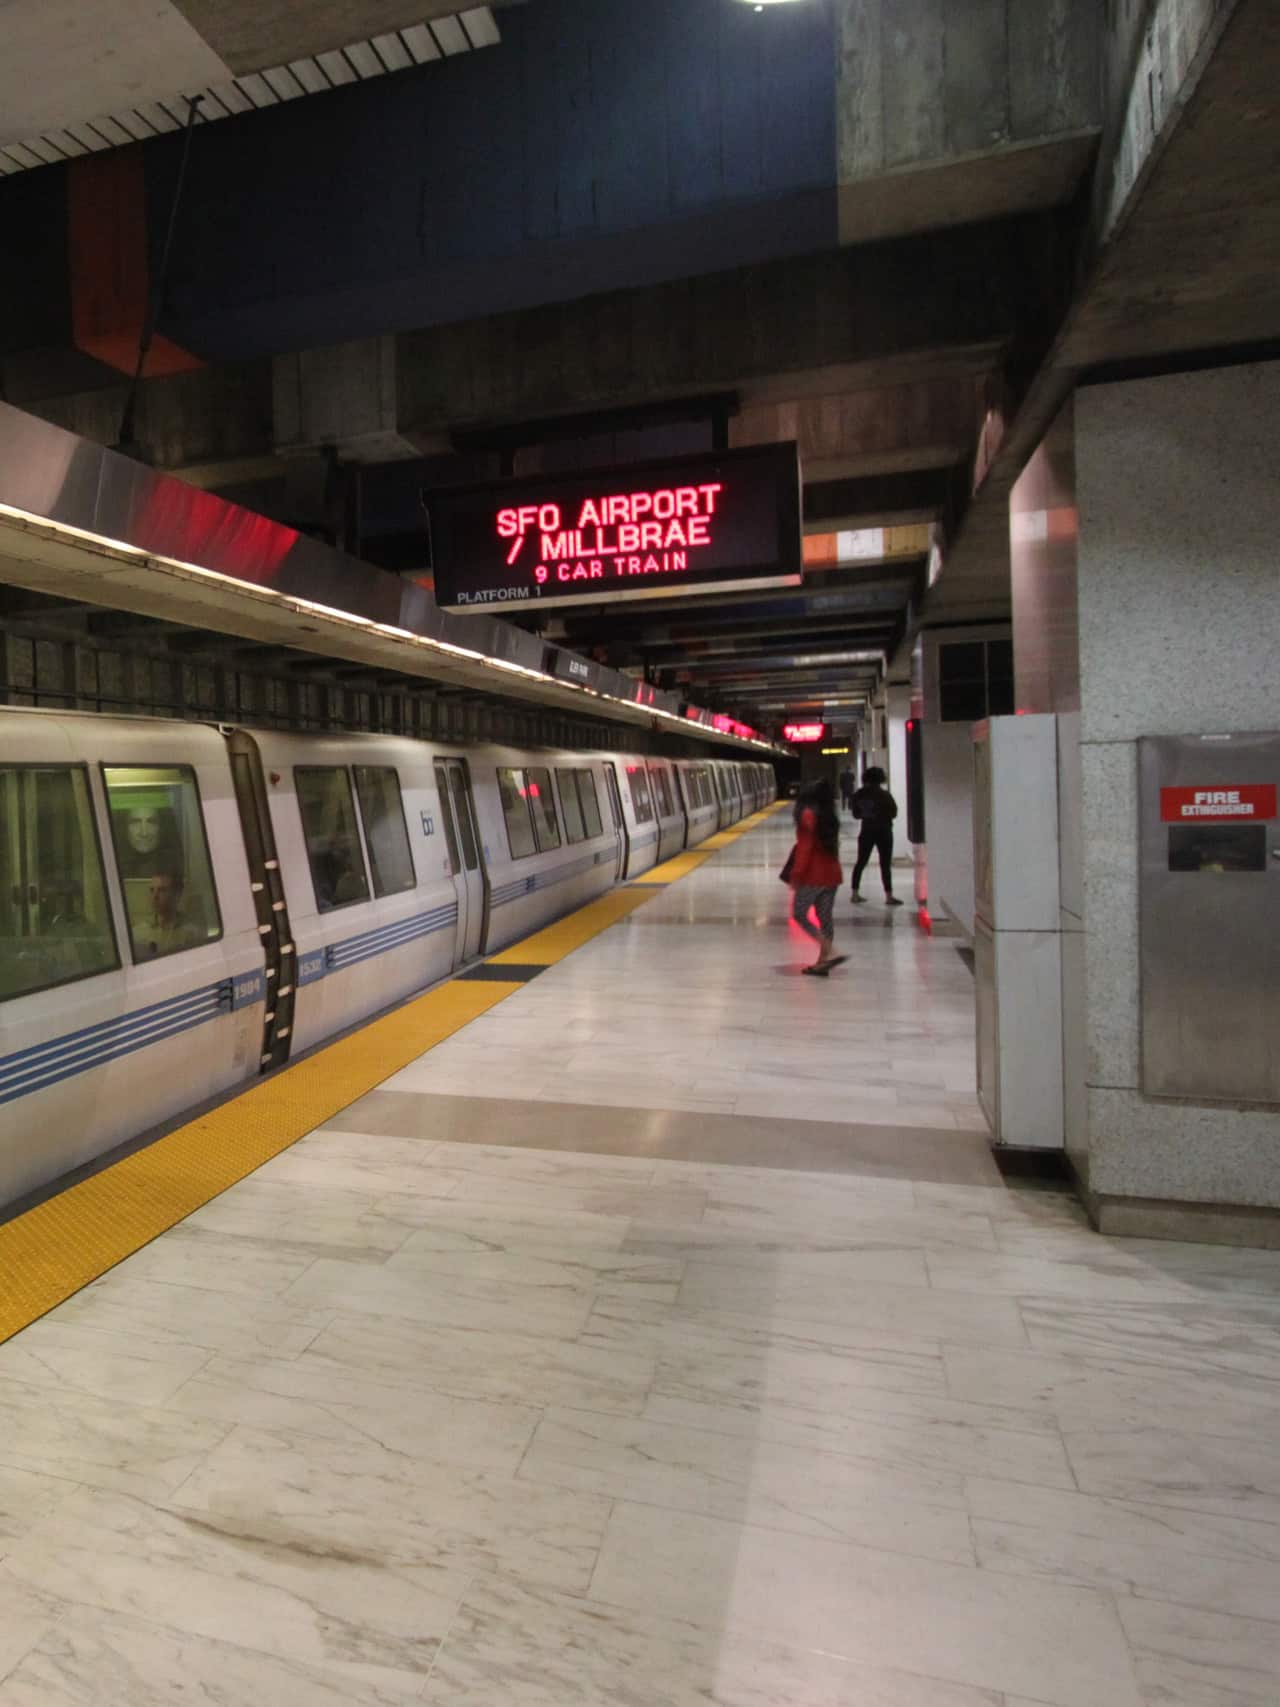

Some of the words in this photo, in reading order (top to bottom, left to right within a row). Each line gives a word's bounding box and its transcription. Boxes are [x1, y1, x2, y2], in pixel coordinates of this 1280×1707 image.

[497, 504, 560, 538] SFO
[578, 484, 721, 528] AIRPORT
[541, 516, 711, 561] MILLBRAE
[535, 567, 548, 584] 9
[558, 562, 602, 580] CAR
[614, 552, 687, 576] TRAIN
[457, 587, 529, 604] PLATFORM
[1181, 803, 1254, 816] EXTINGUISHER
[1194, 791, 1240, 804] FIRE
